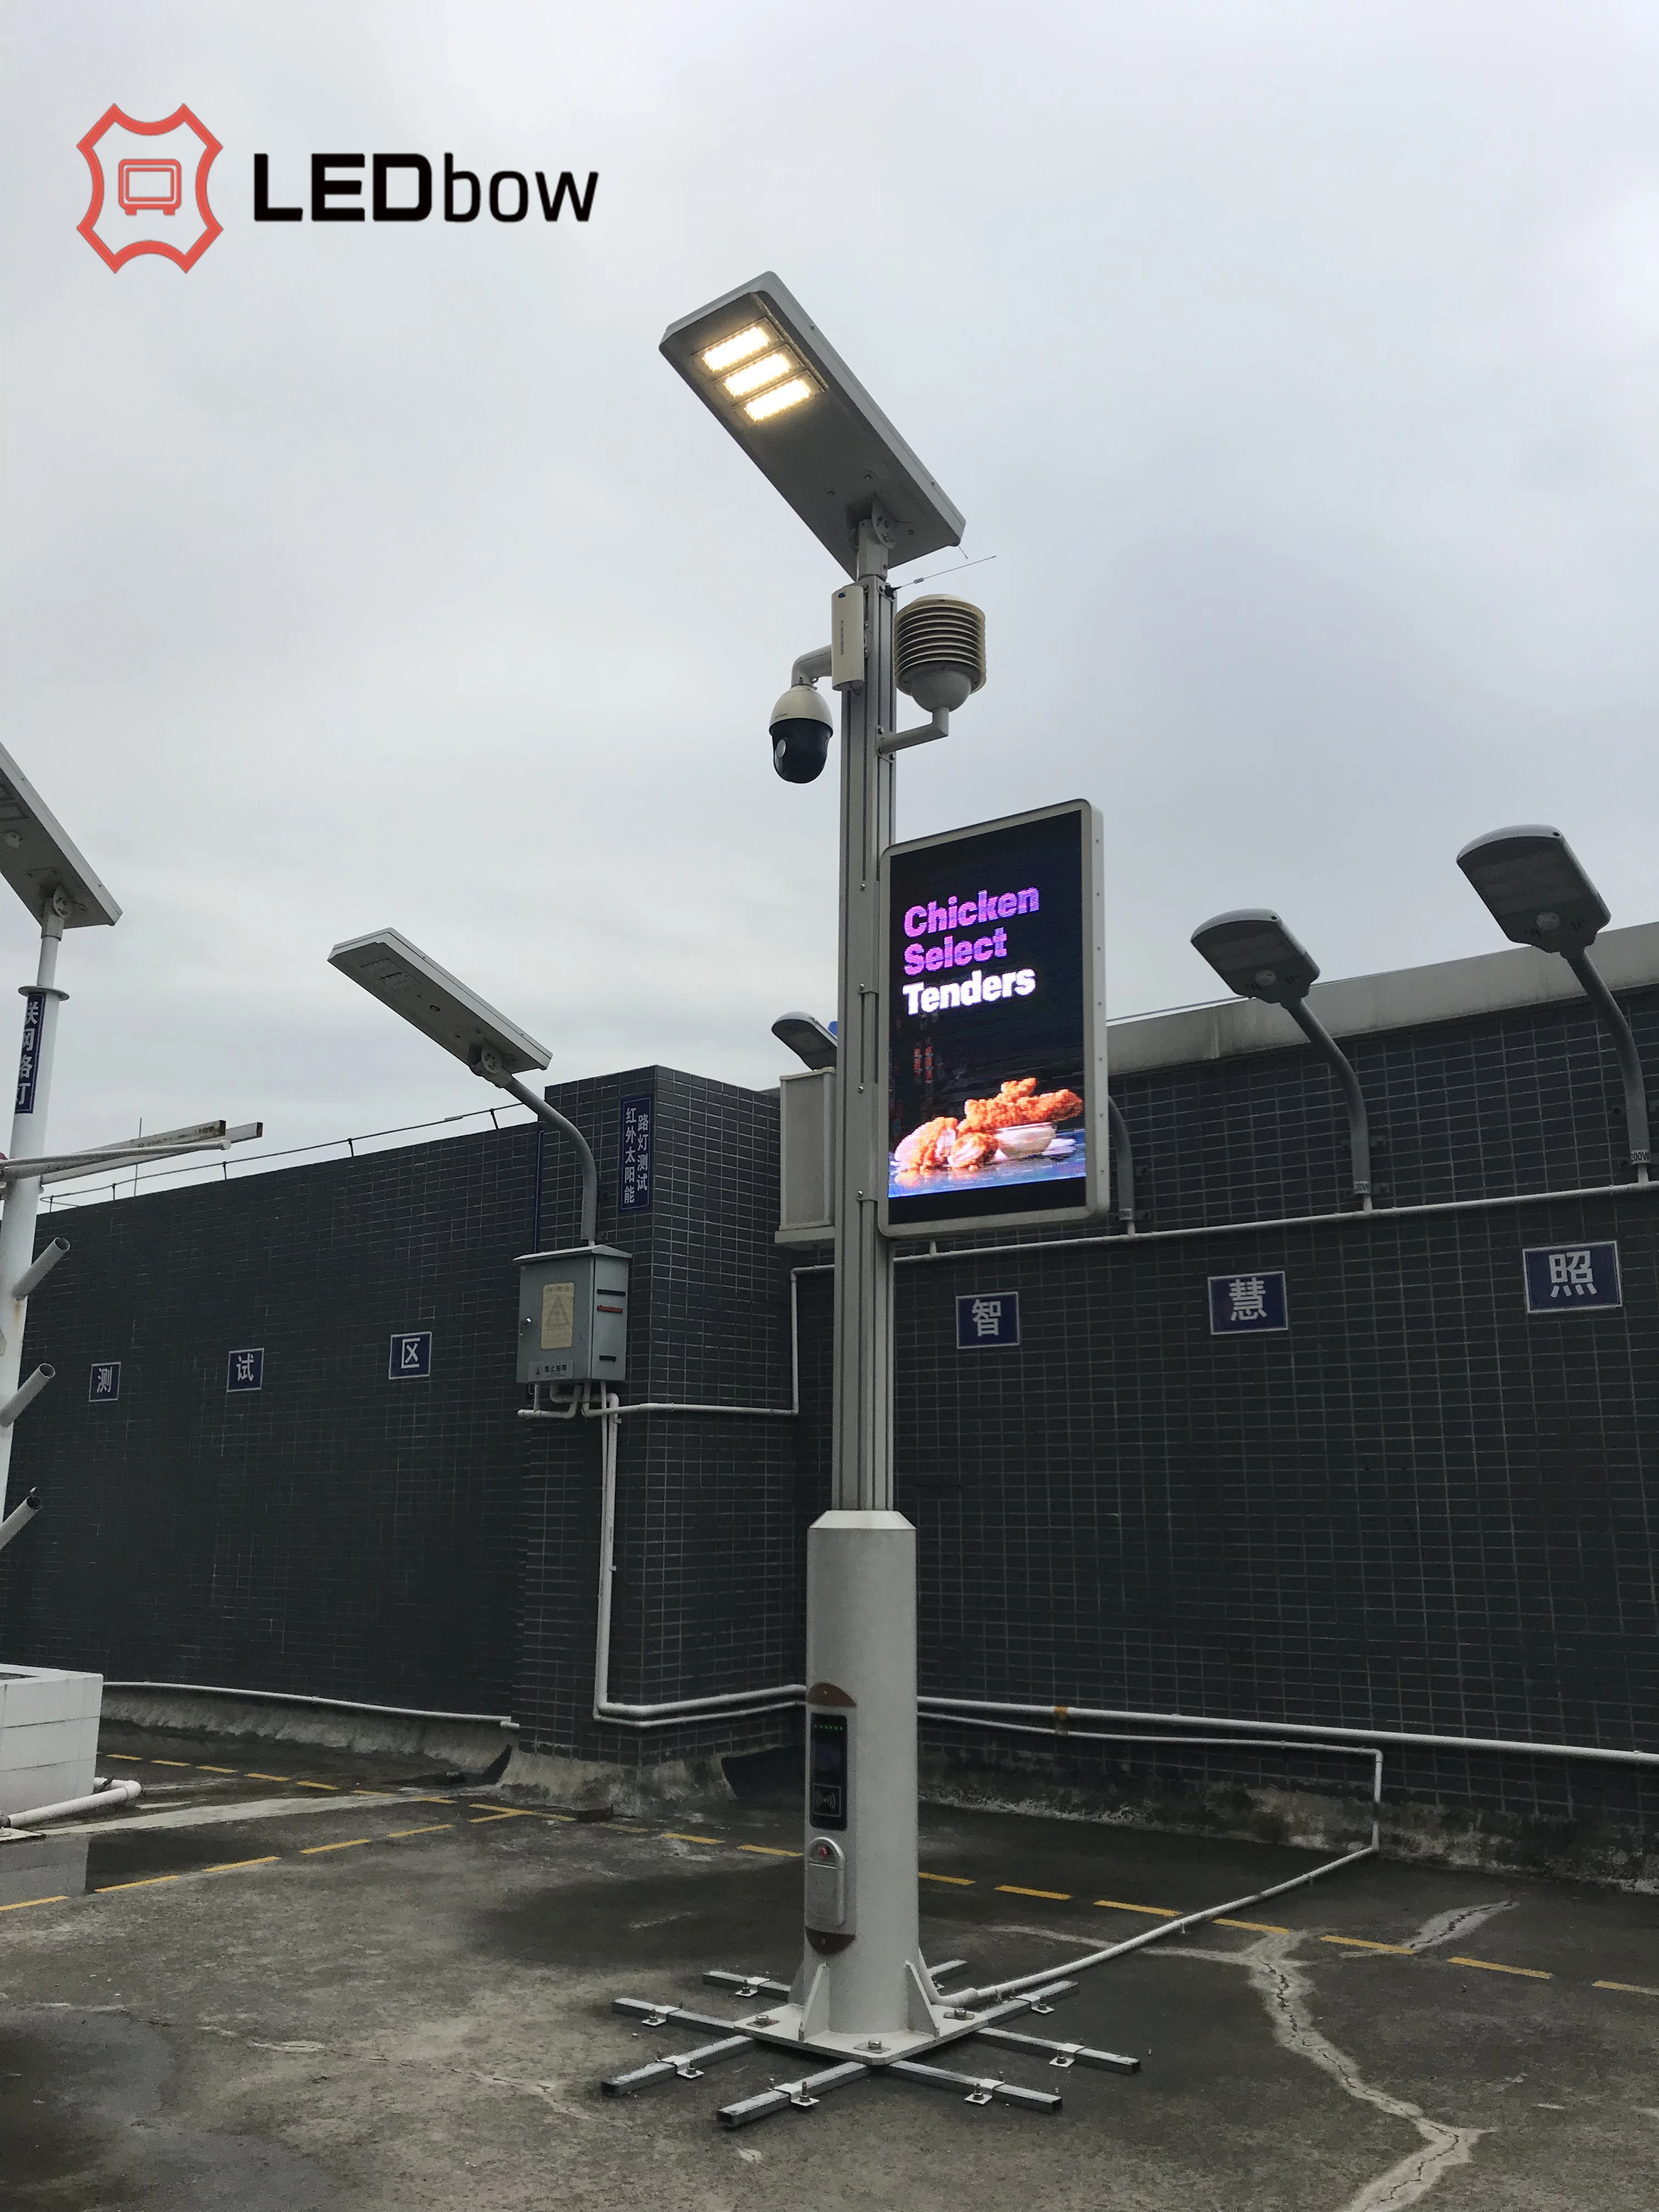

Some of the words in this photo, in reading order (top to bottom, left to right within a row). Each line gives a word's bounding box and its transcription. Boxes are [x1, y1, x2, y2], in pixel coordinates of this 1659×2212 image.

[903, 887, 1040, 938] Chicken
[903, 927, 1008, 976] Select
[902, 968, 1036, 1015] Tenders
[624, 1107, 637, 1204] 红外太阳能
[636, 1113, 650, 1191] 路灯测试
[971, 1298, 1002, 1337] 智
[1228, 1277, 1267, 1322] 慧
[1549, 1250, 1598, 1299] 照
[97, 1367, 113, 1393] 测
[236, 1353, 255, 1382] 试
[400, 1338, 421, 1369] 区
